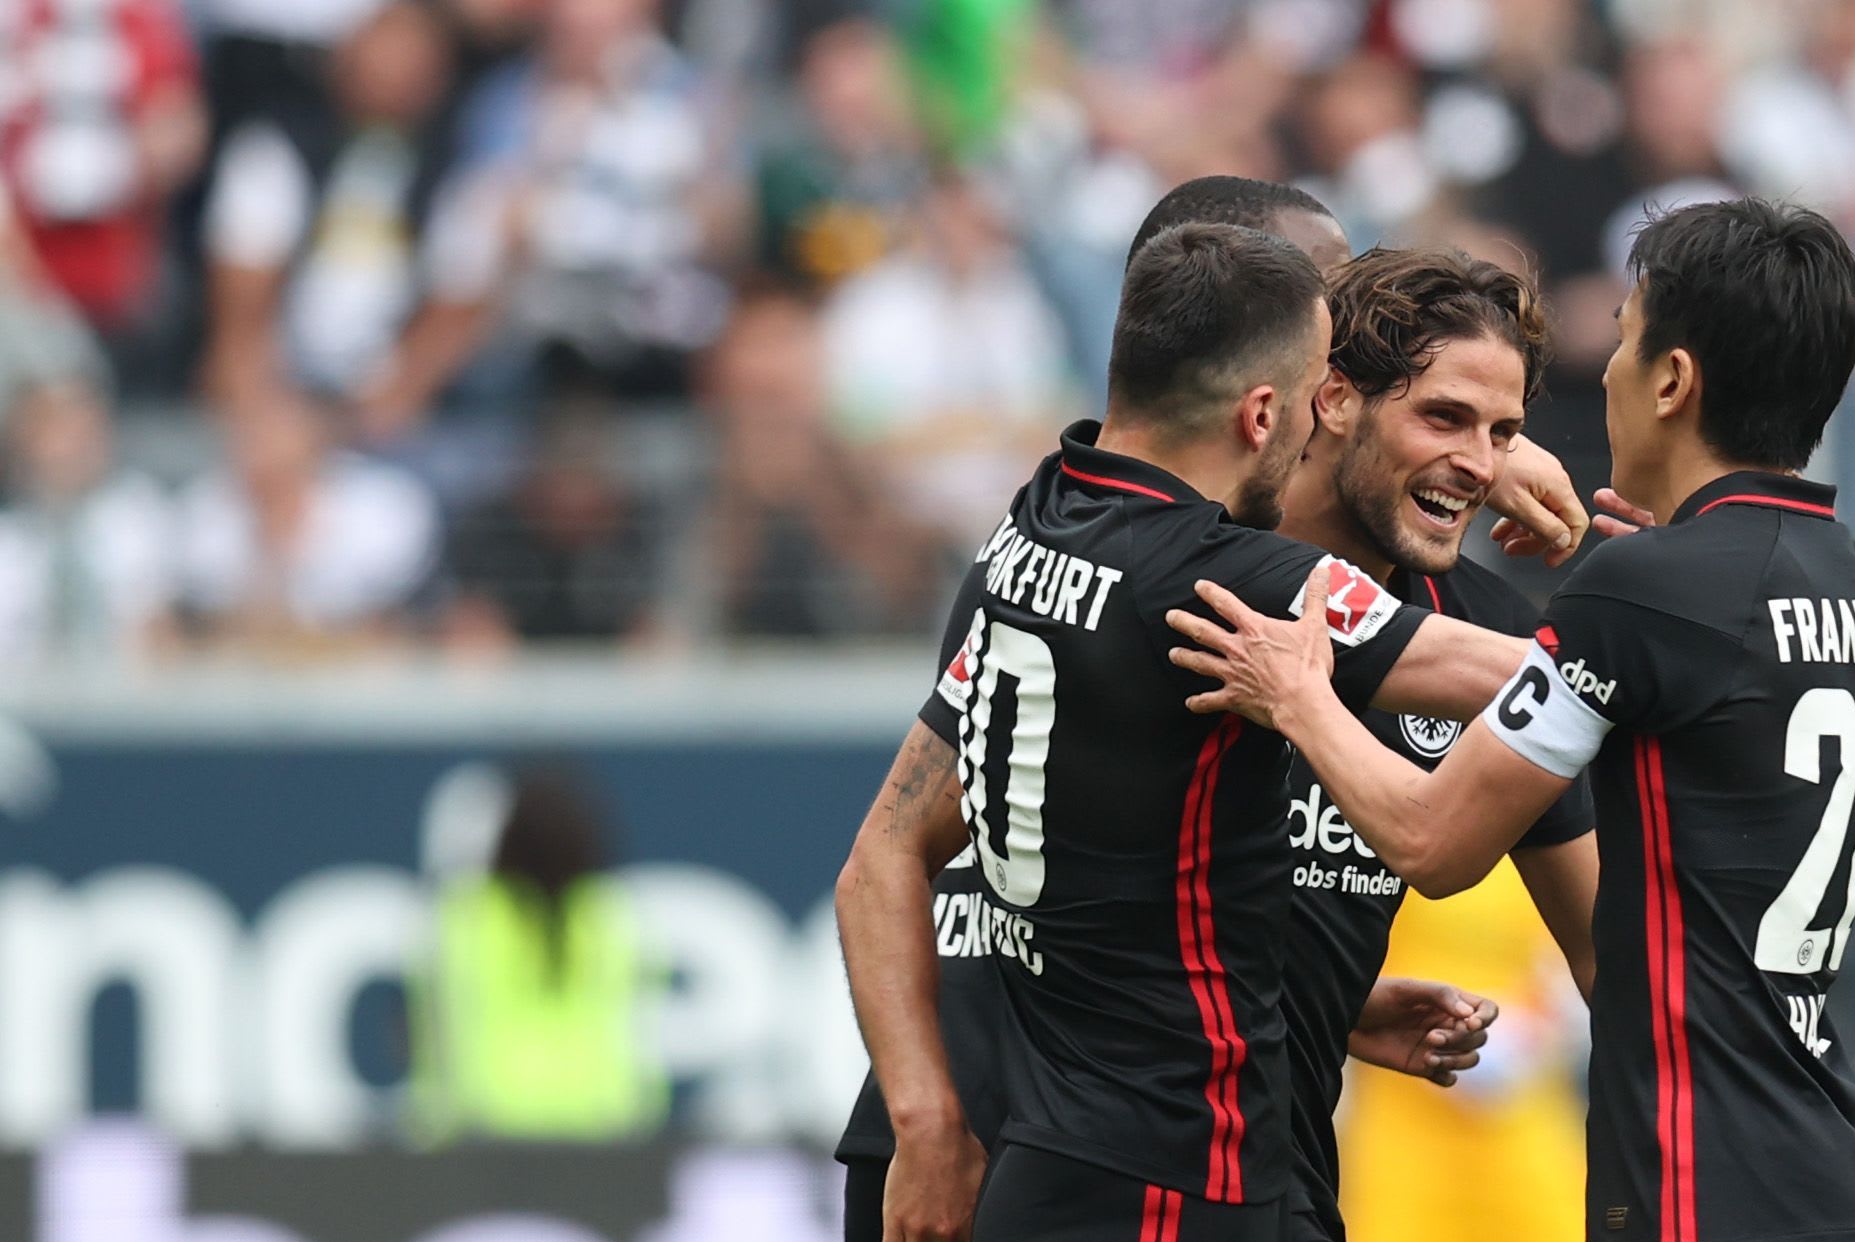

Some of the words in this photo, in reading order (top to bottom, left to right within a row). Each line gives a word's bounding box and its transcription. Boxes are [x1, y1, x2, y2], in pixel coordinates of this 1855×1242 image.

[1498, 665, 1550, 731] C
[1560, 658, 1617, 705] dpd
[1293, 861, 1338, 889] obs
